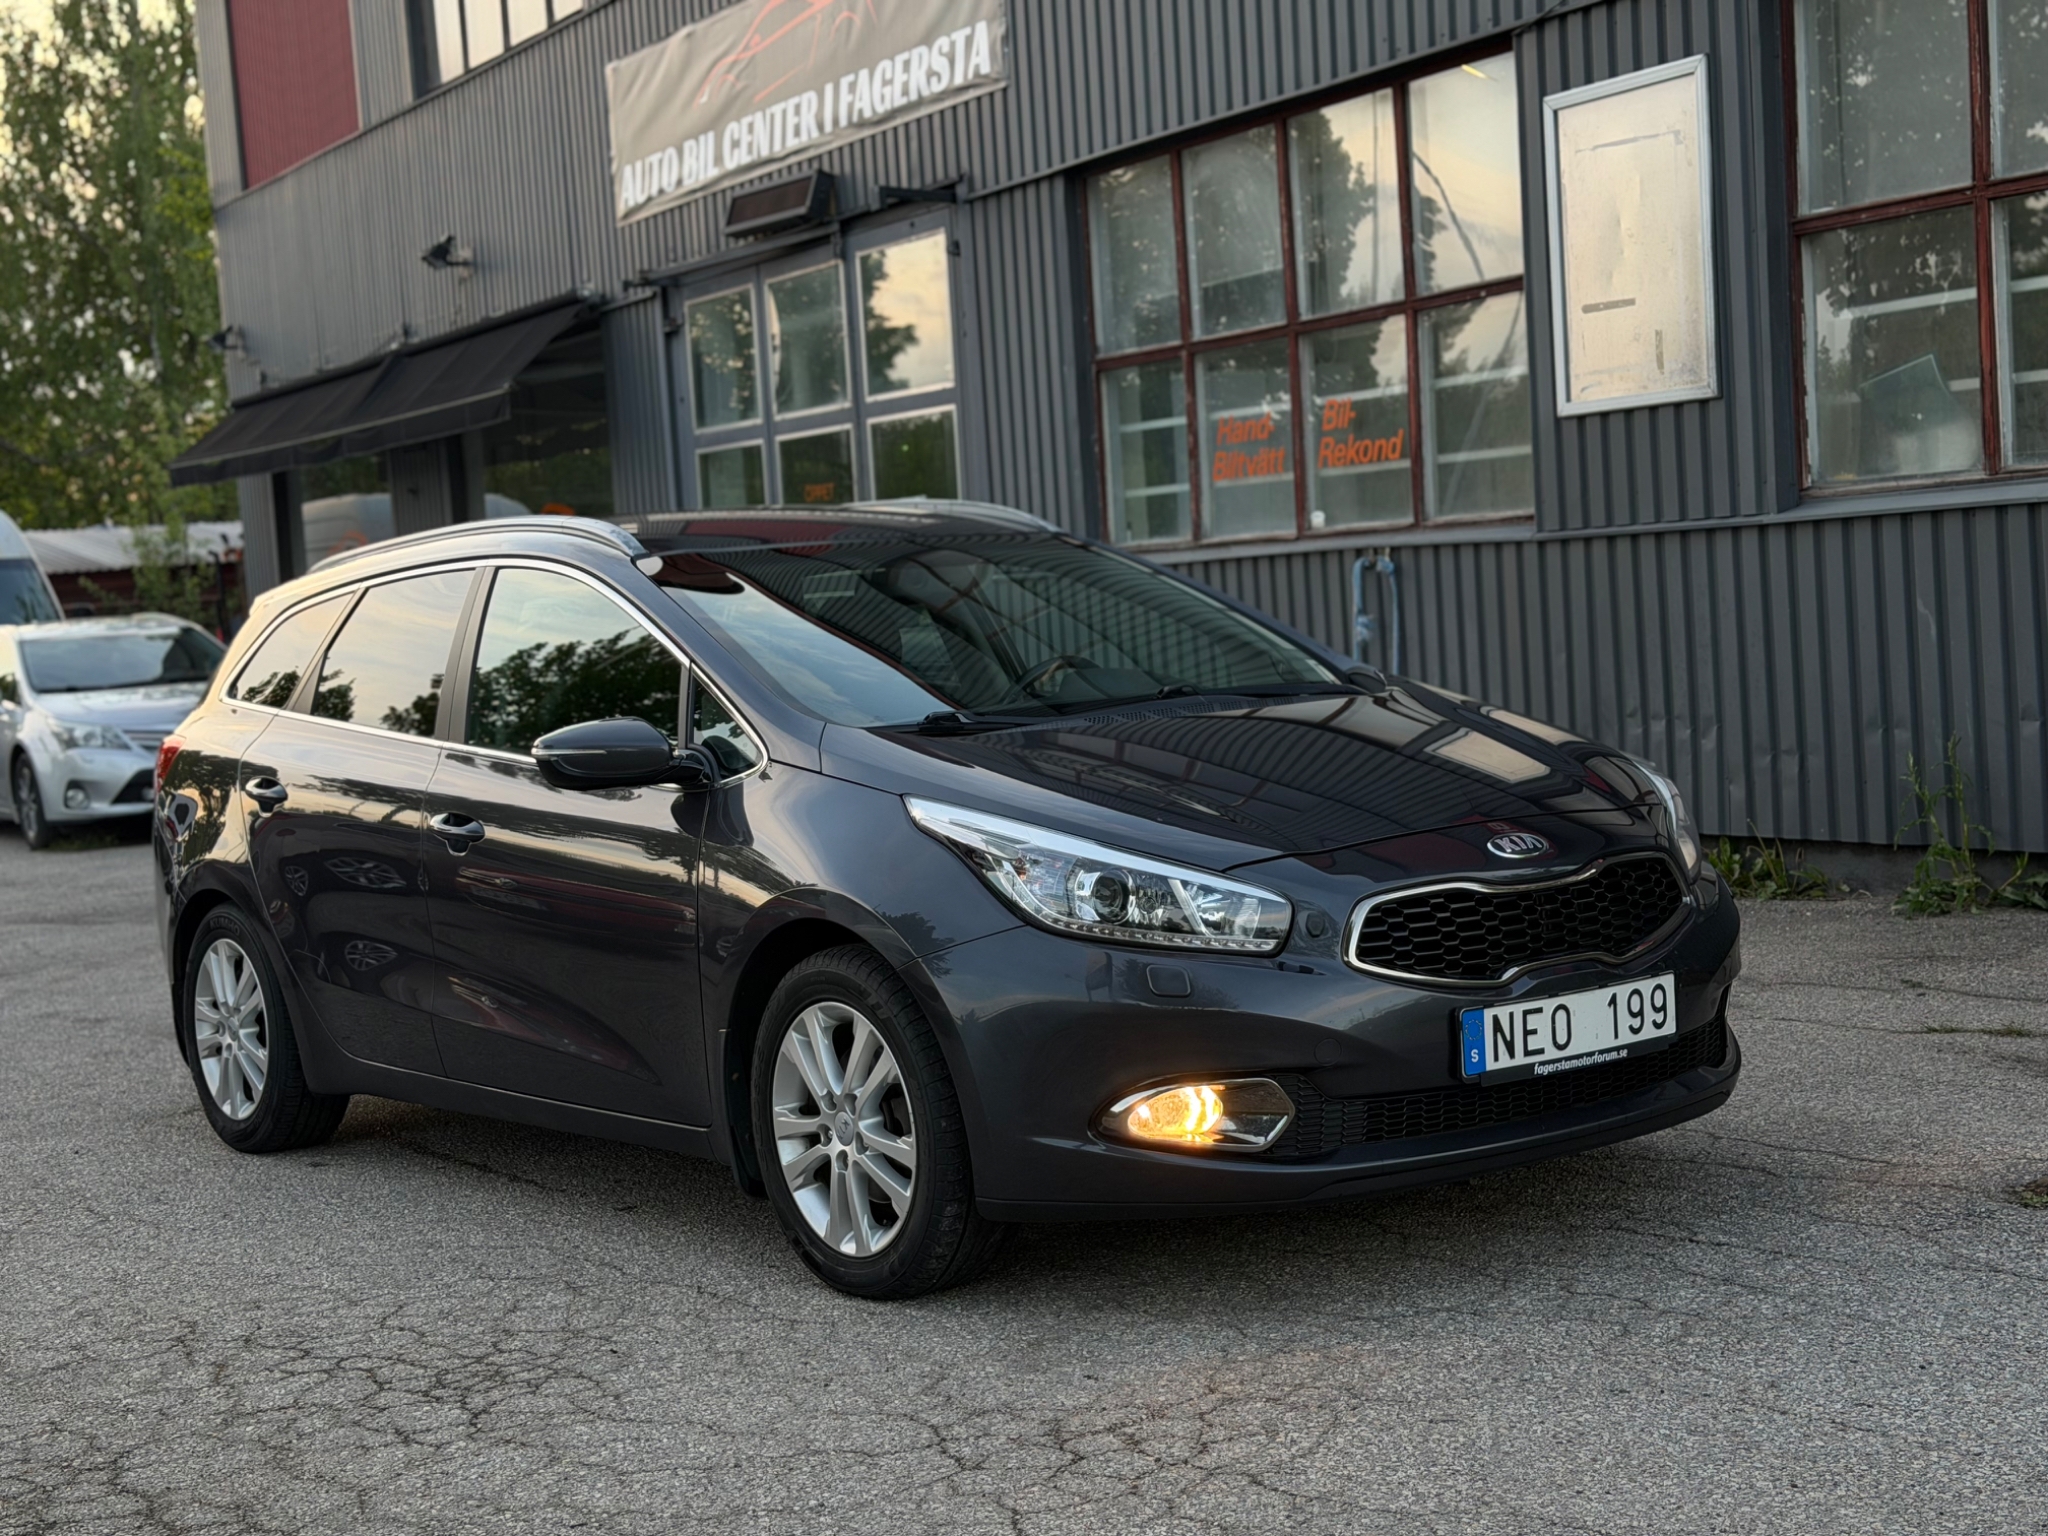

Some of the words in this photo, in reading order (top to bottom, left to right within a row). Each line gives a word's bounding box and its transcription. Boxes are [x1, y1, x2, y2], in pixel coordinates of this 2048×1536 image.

[621, 146, 680, 209] AUTO
[682, 130, 719, 187] BIL
[722, 90, 820, 171] CENTER
[823, 82, 835, 135] I
[837, 20, 992, 129] FAGERSTA
[1216, 411, 1275, 447] Hand-
[1321, 397, 1357, 432] Bil-
[1317, 428, 1405, 469] Rekond
[1491, 1003, 1573, 1063] NEO
[1606, 983, 1668, 1041] 199
[1470, 1048, 1479, 1063] S
[1533, 1047, 1629, 1076] fagerstamotorforum.se
